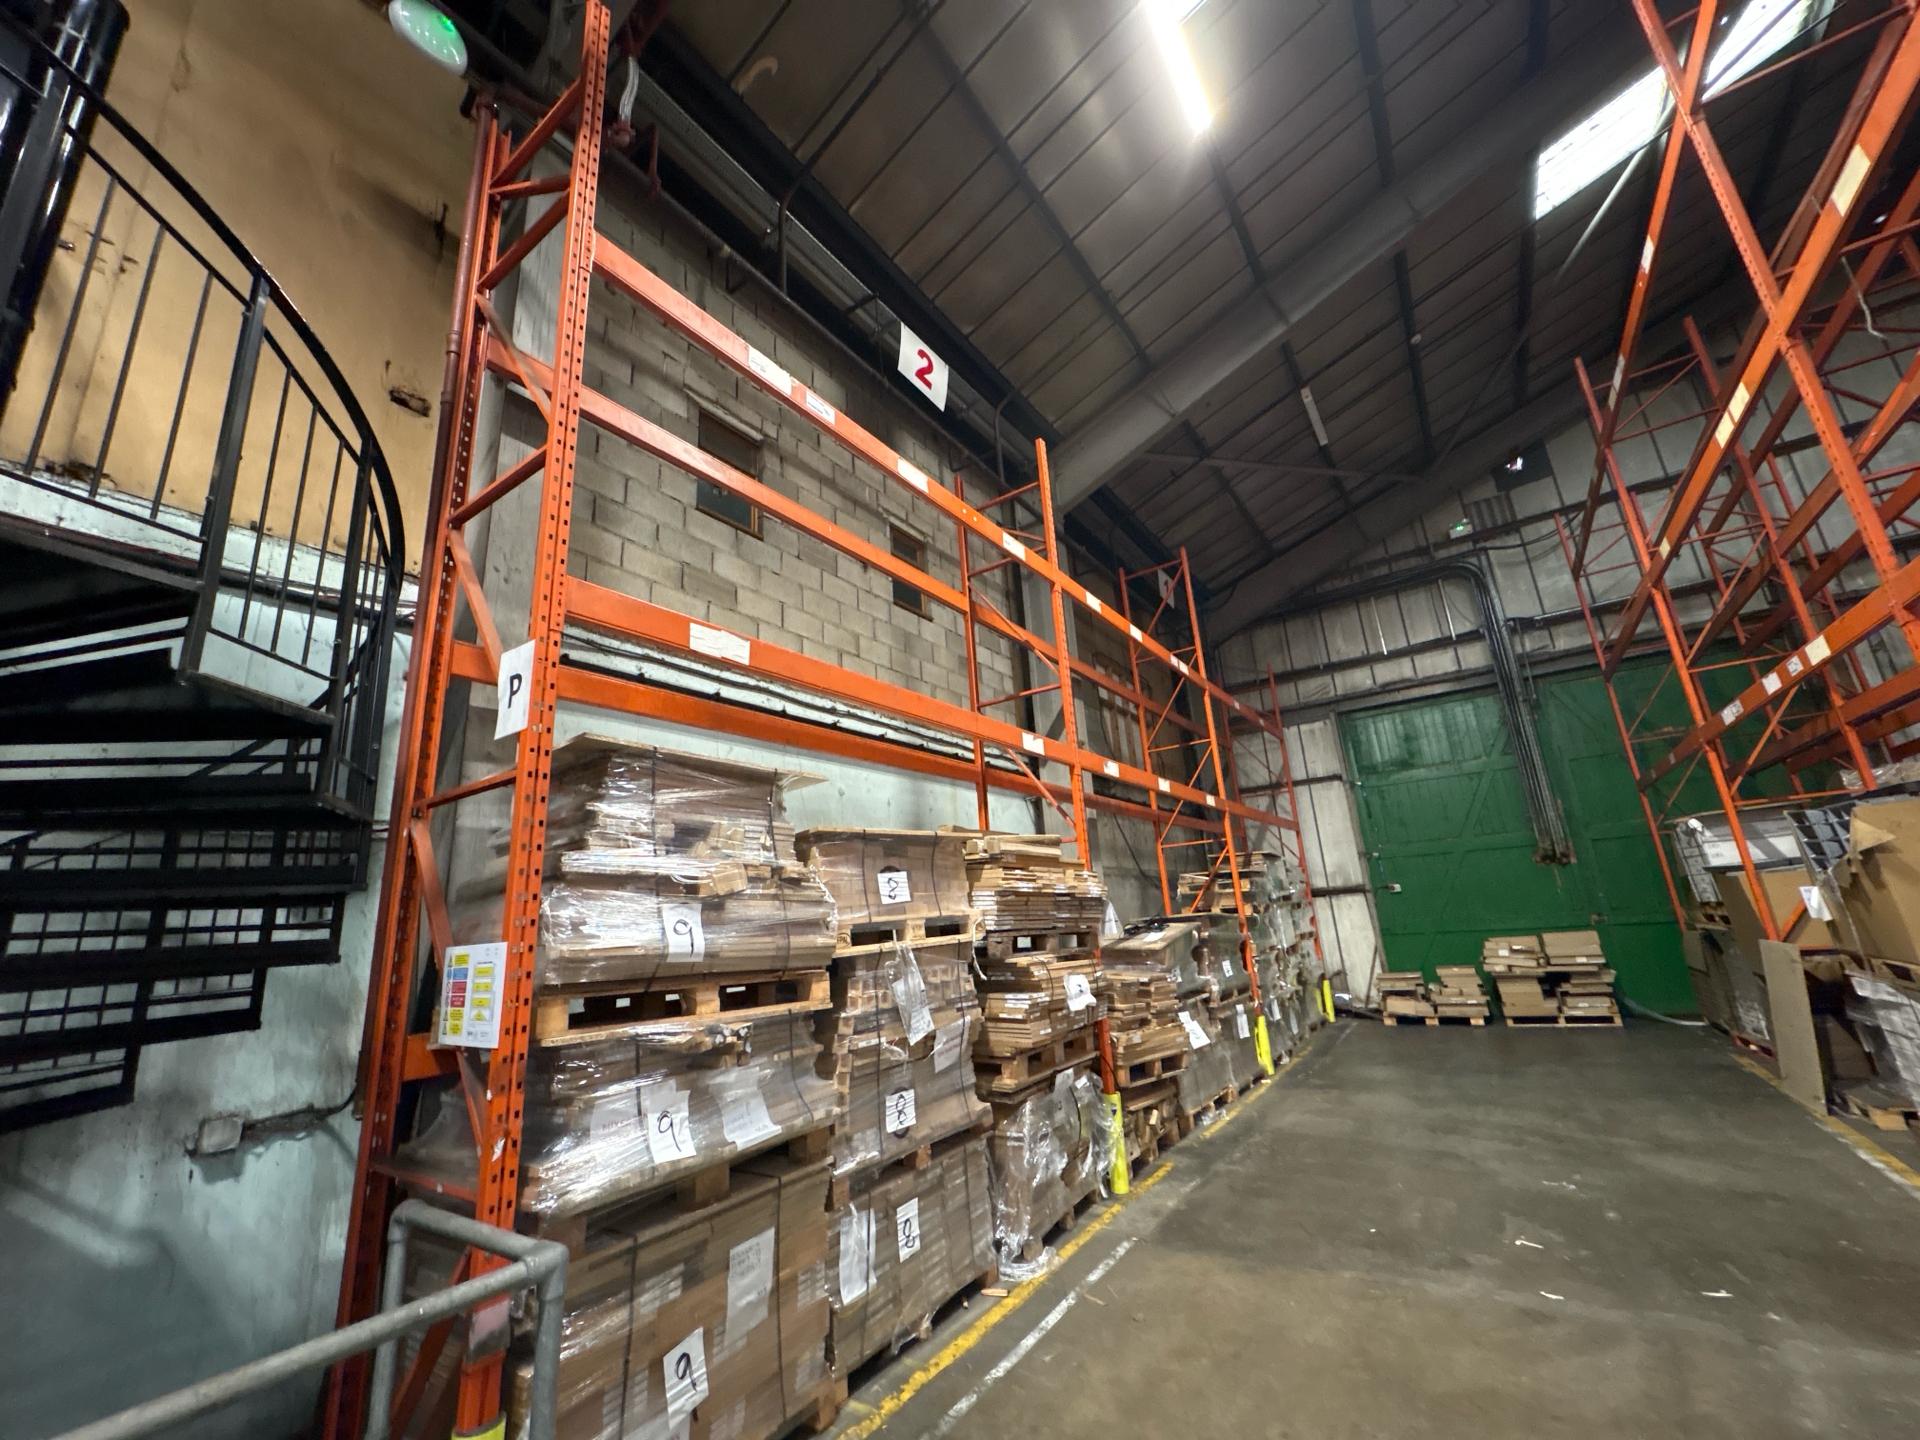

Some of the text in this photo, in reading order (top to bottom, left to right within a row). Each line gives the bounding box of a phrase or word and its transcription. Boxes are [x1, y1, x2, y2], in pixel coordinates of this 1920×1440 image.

[914, 348, 934, 391] 2
[507, 673, 523, 709] P
[673, 919, 694, 958] 9
[657, 1110, 682, 1153] 9
[903, 1218, 916, 1248] 8
[675, 1351, 698, 1392] 9
